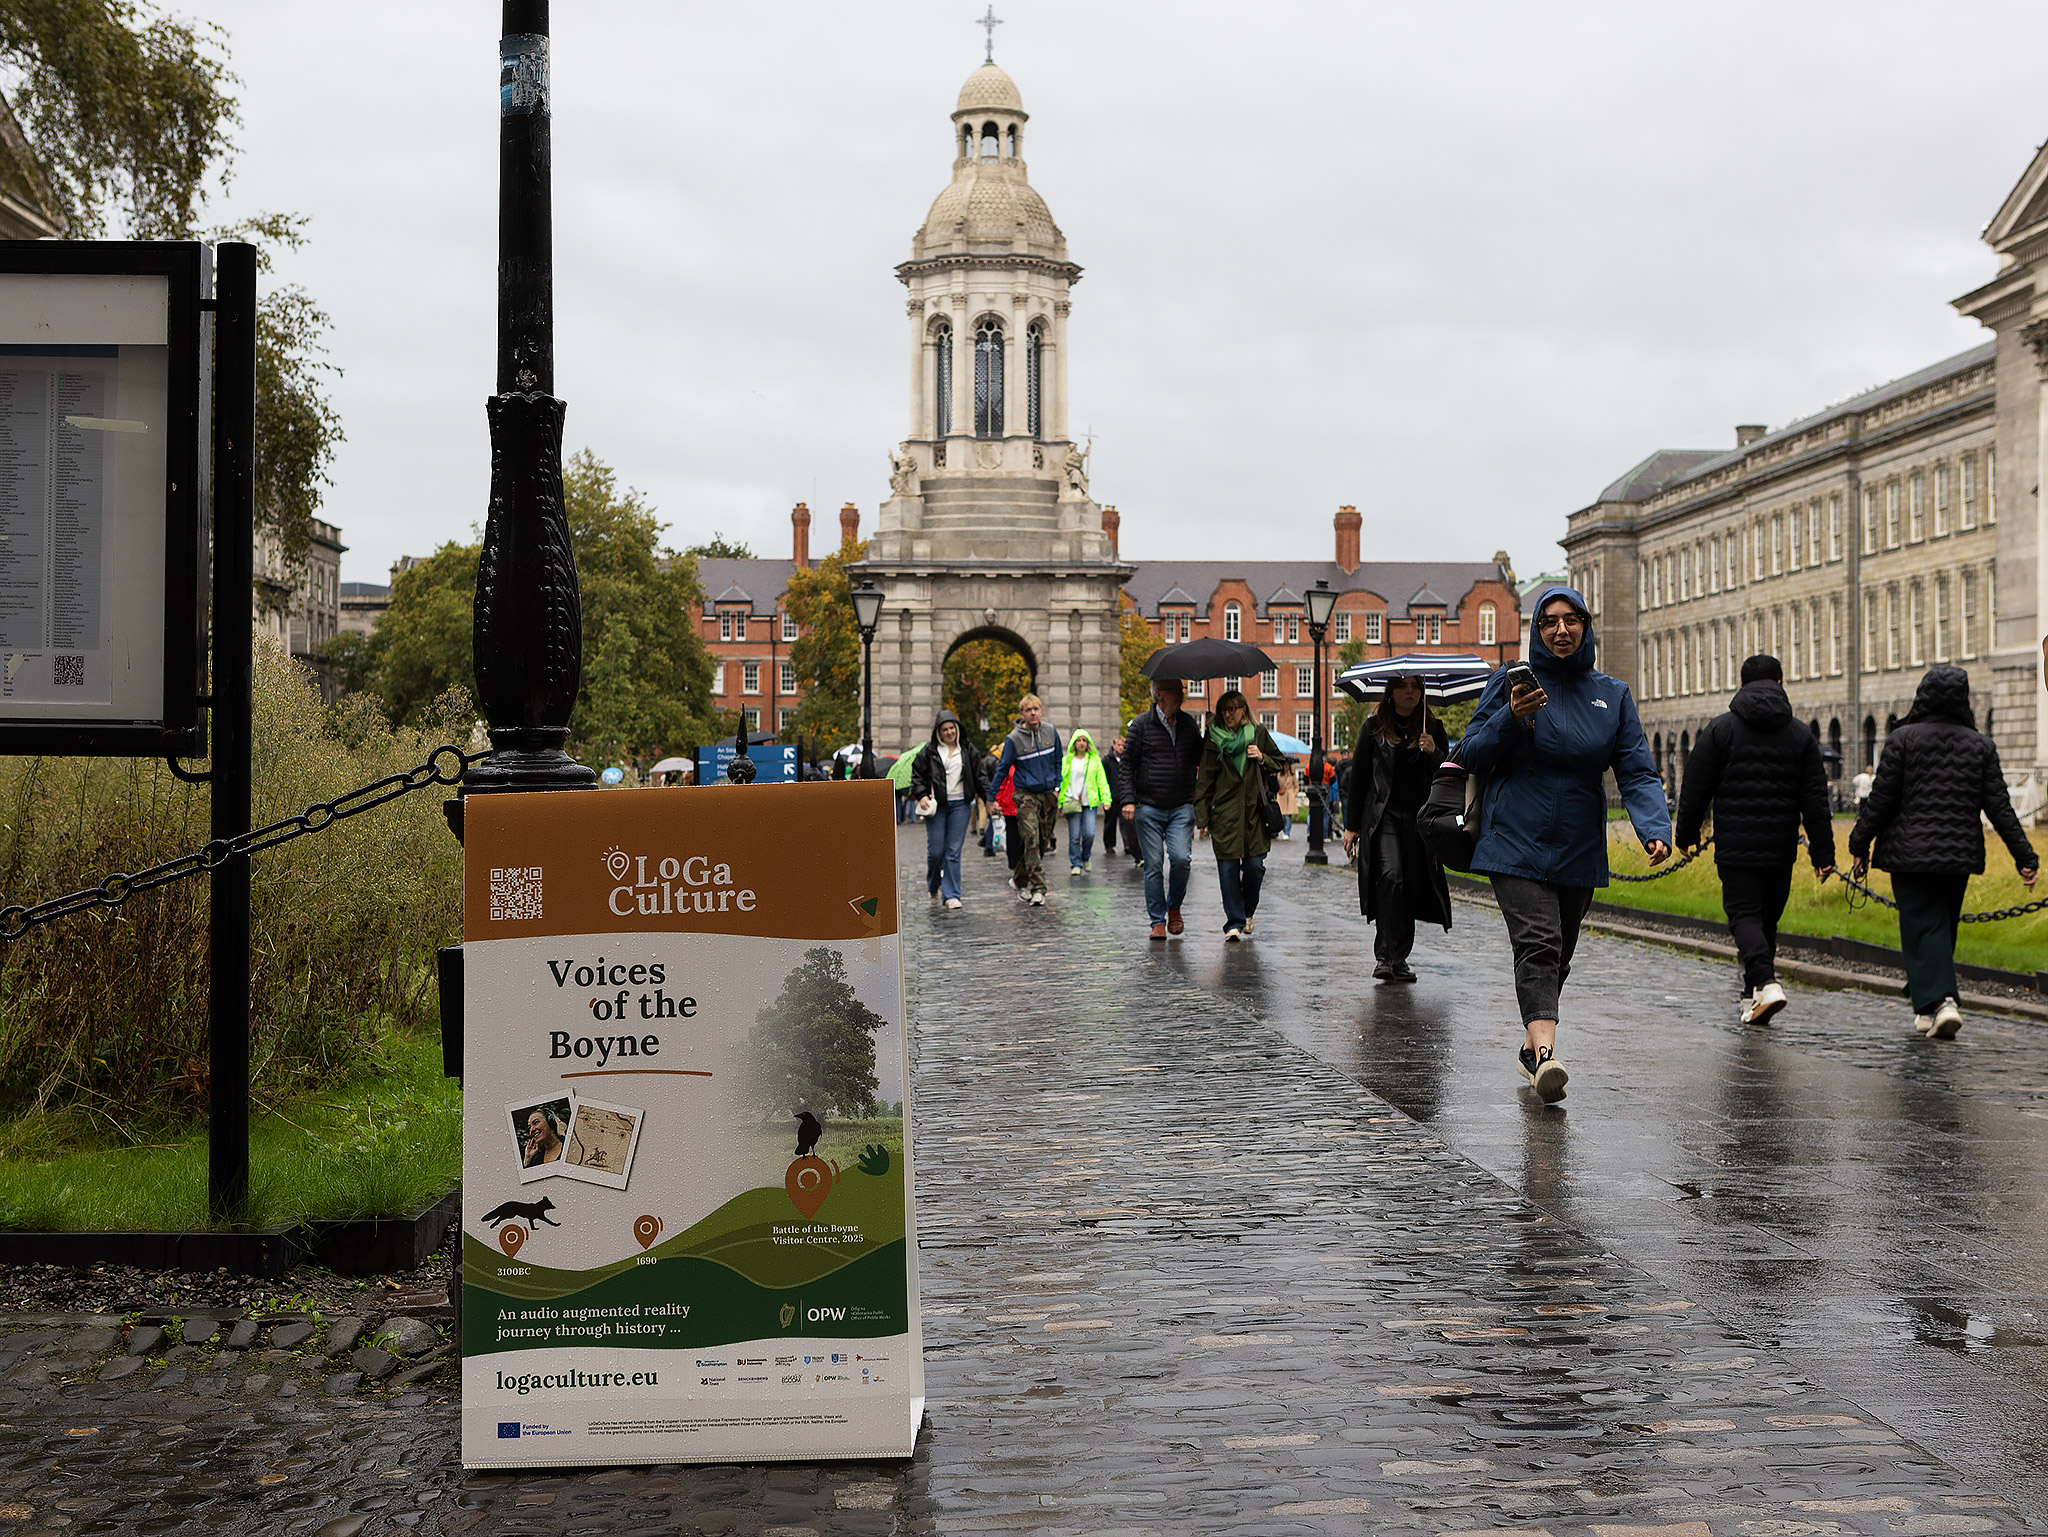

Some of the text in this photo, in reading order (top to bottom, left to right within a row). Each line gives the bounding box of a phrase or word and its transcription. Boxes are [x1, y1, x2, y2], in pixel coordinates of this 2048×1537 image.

[635, 856, 733, 888] LoGa
[608, 881, 756, 916] Culture
[547, 957, 666, 987] Voices
[593, 989, 697, 1020] of the
[549, 1031, 660, 1067] Boyne
[772, 1224, 858, 1234] Battle of the Boyne
[772, 1234, 864, 1244] Visitor Centre, 2025
[636, 1257, 657, 1265] 1690
[497, 1267, 531, 1276] 3100BC
[498, 1303, 690, 1321] An audio augmented reality
[807, 1307, 846, 1322] OPW
[496, 1325, 551, 1341] journey
[555, 1322, 611, 1338] through
[616, 1322, 666, 1336] history
[496, 1369, 658, 1395] logaculture.eu
